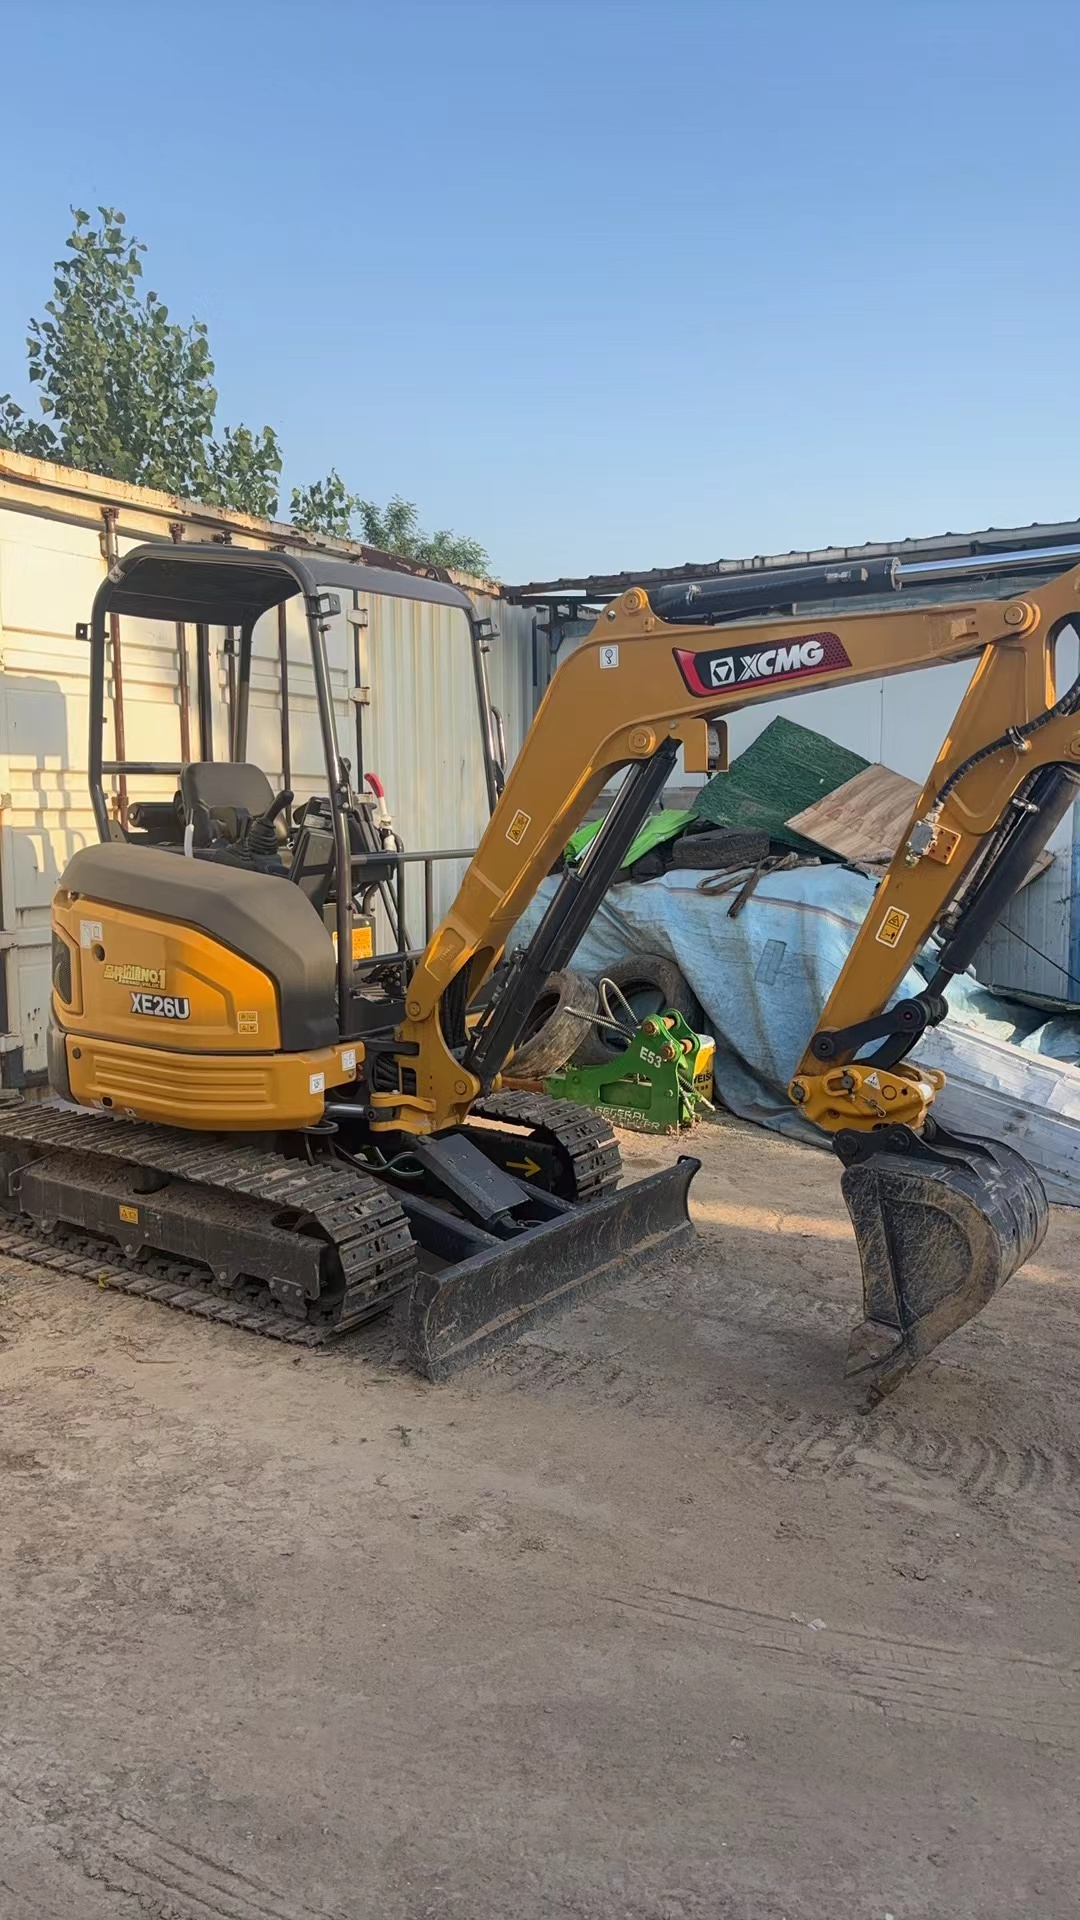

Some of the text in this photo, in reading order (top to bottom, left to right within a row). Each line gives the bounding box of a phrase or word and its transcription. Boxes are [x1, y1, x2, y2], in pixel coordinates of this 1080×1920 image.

[737, 640, 824, 682] XCMG
[130, 992, 189, 1019] XE26U
[640, 1046, 662, 1069] E53
